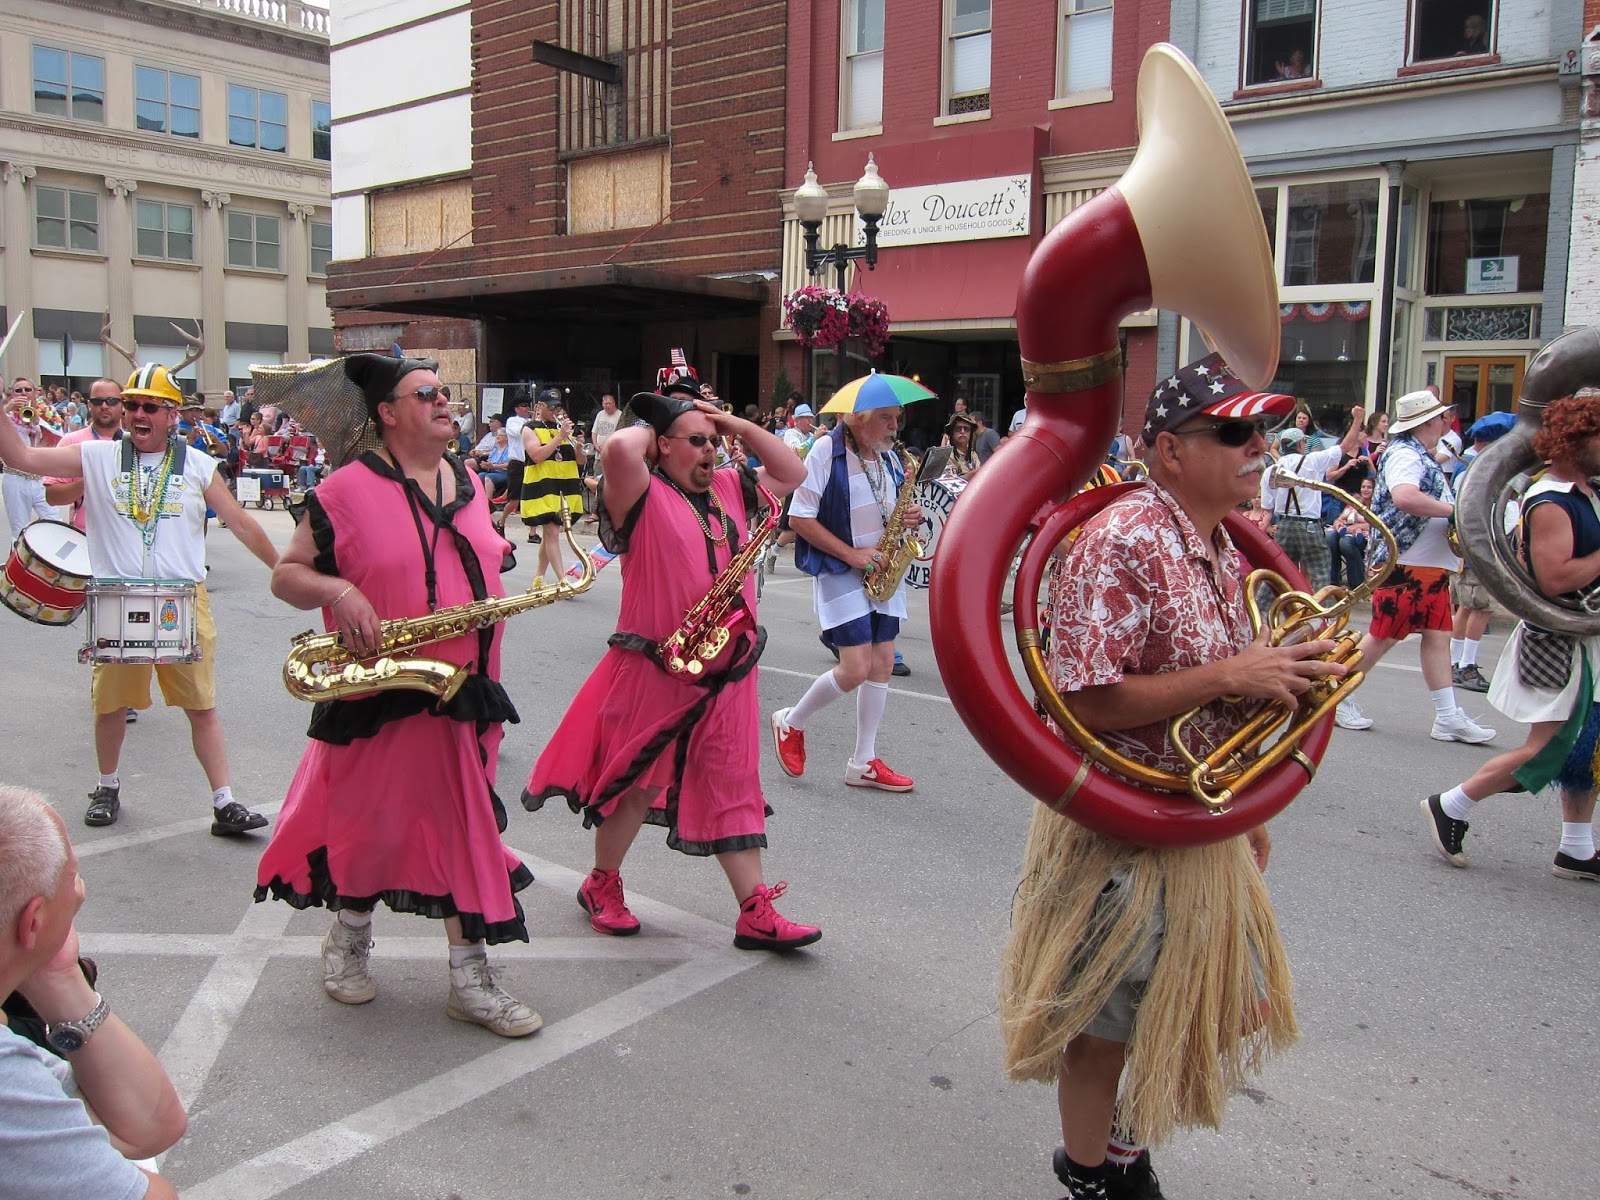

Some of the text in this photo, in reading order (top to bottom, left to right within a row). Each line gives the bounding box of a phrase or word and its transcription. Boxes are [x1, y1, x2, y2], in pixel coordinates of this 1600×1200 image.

[40, 135, 141, 165] MANISTEE
[156, 154, 228, 177] COUNTY
[236, 166, 305, 189] SAVINGS
[923, 187, 1016, 222] Doucett's
[883, 228, 911, 237] BEDDING
[918, 225, 943, 234] UNIQUE
[944, 221, 986, 231] HOUSEHOLD
[987, 218, 1013, 227] GOODS
